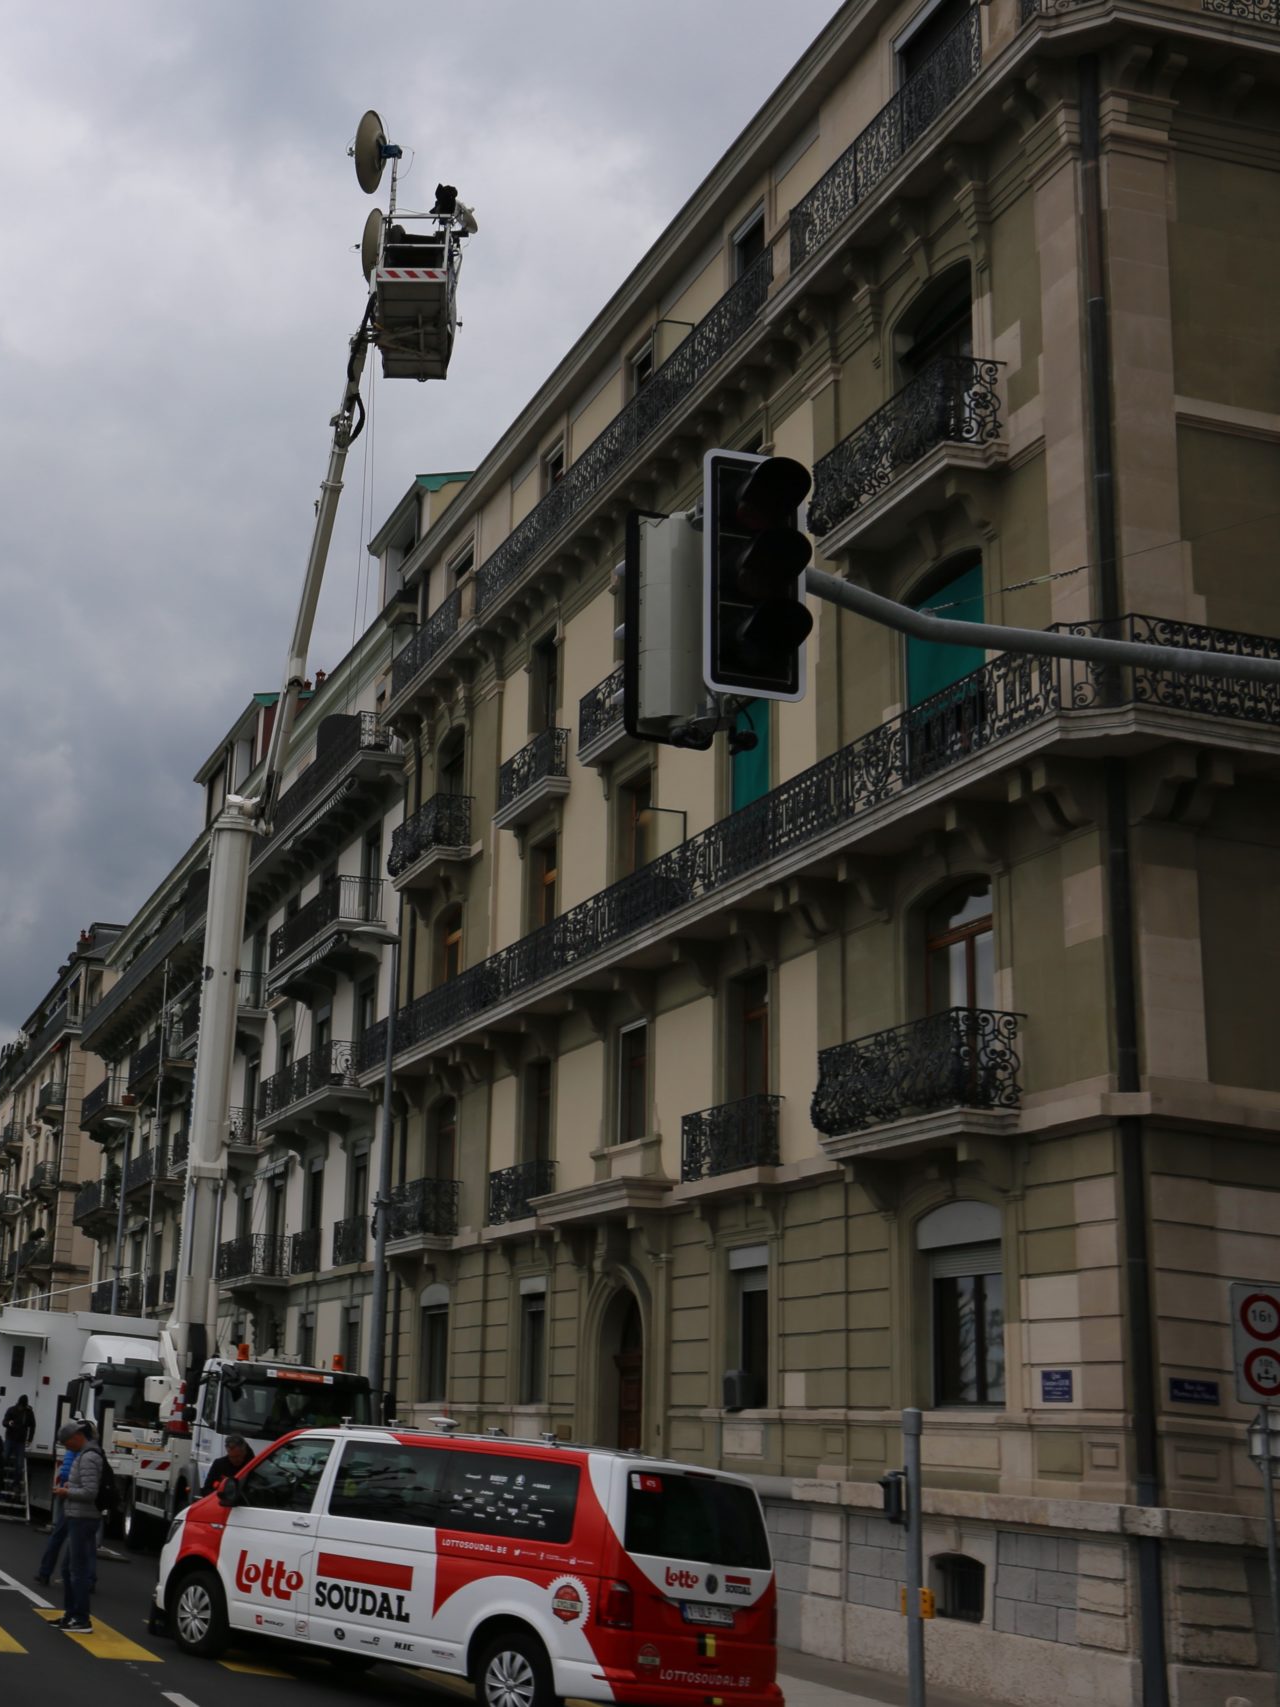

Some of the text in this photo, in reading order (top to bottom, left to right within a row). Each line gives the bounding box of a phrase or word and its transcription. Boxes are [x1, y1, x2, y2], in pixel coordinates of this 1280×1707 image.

[1251, 1309, 1272, 1323] 16t
[442, 1538, 508, 1555] LOTTOSOUDAL.BE
[725, 1584, 752, 1596] SOUDAL
[315, 1581, 410, 1623] SOUDAL
[659, 1669, 752, 1687] LOTTOSOUDAL.BE
